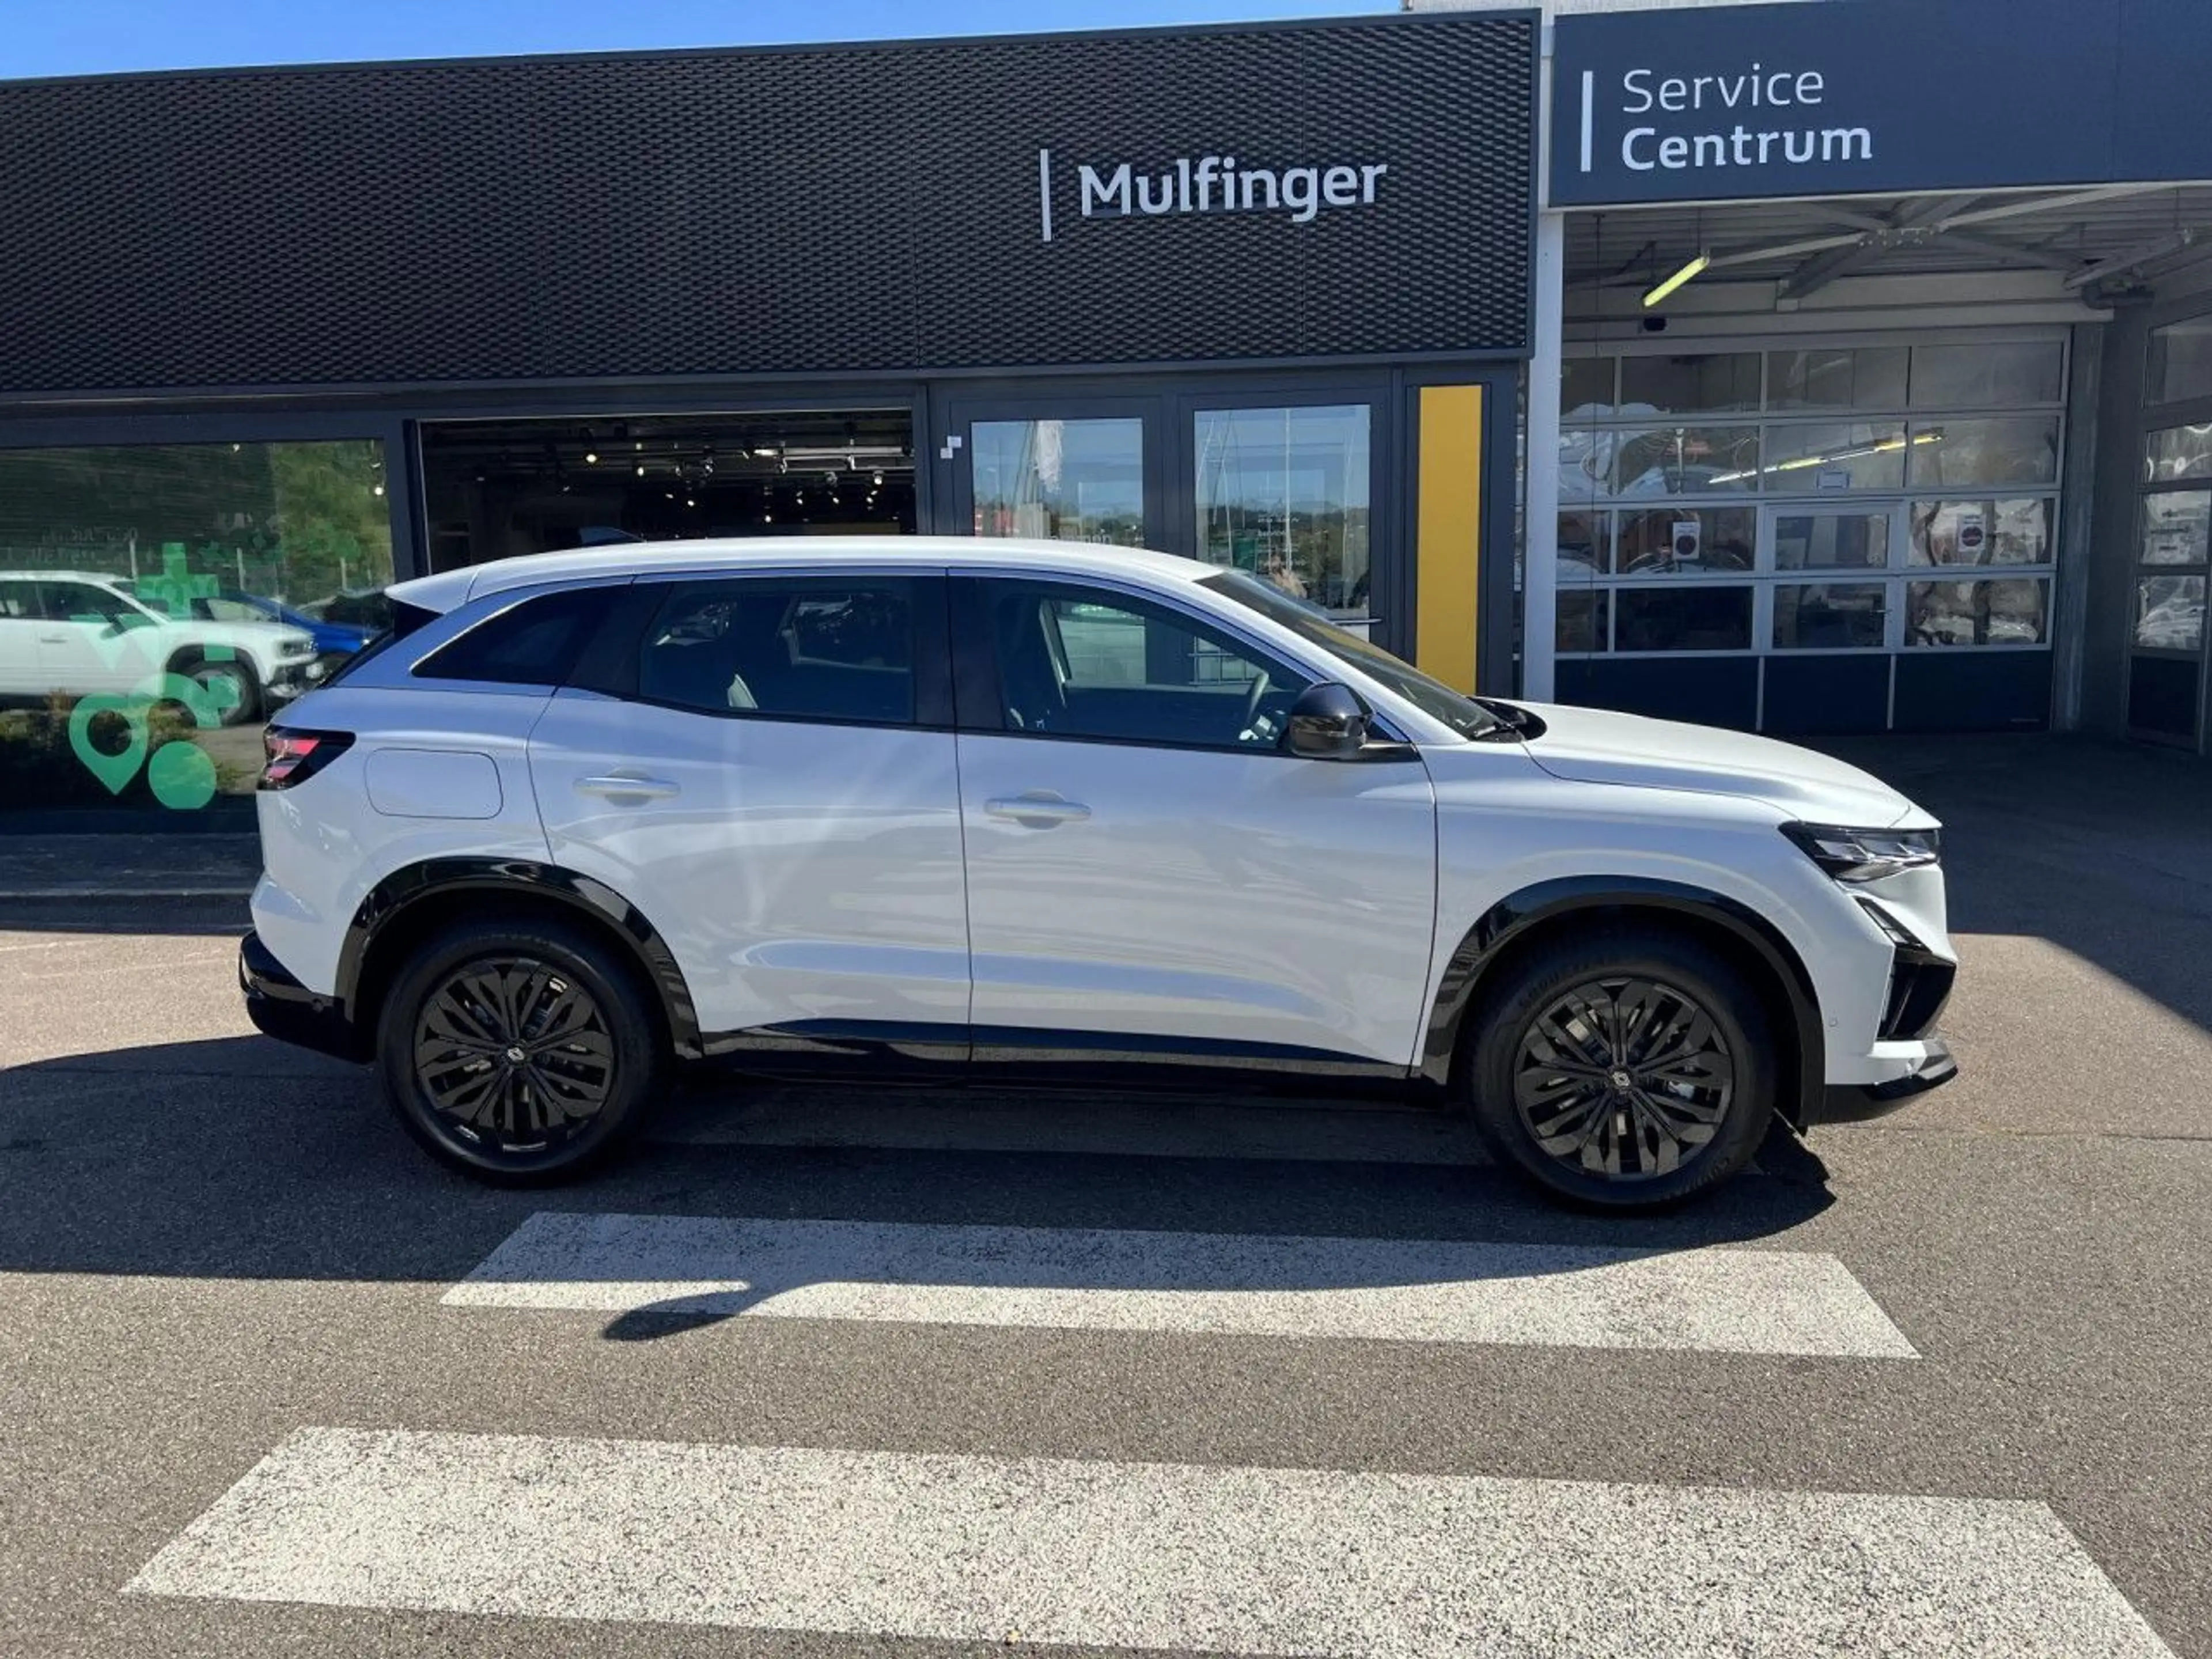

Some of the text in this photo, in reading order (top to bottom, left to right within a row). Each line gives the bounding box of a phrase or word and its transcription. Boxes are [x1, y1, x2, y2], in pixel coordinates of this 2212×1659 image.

[1623, 63, 1824, 113] Service
[1622, 126, 1873, 170] Centrum
[1078, 156, 1388, 222] Mulfinger
